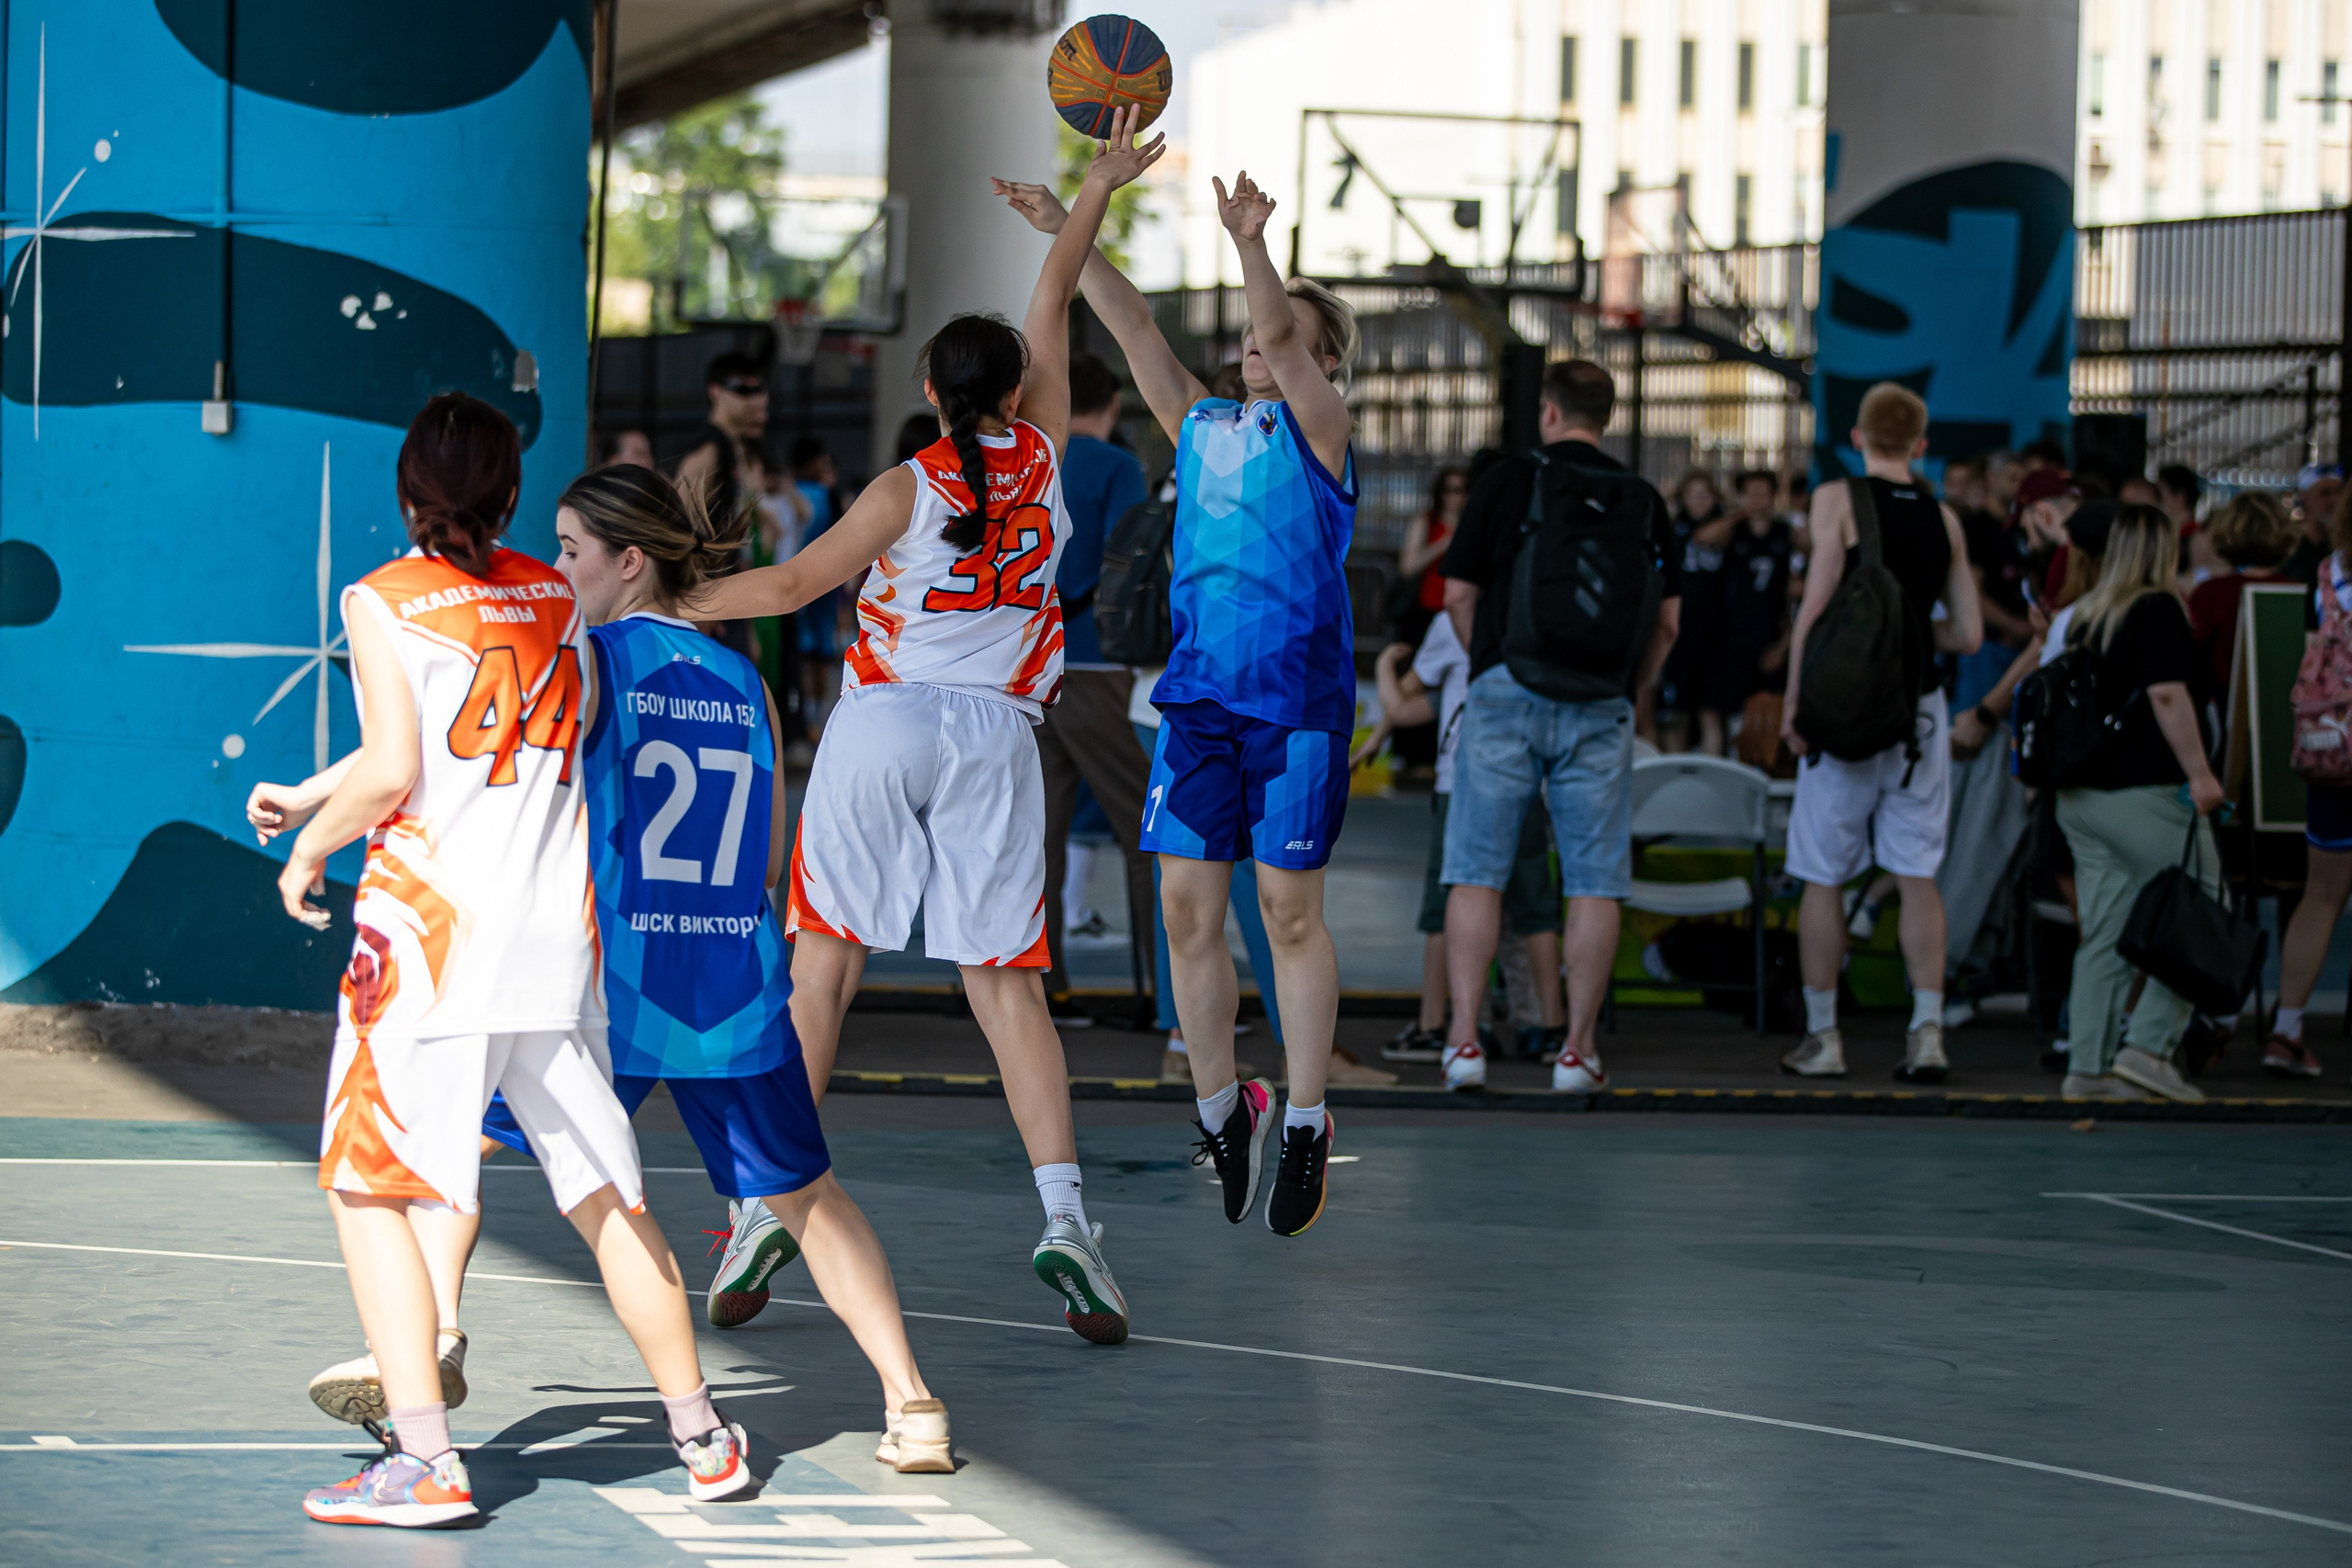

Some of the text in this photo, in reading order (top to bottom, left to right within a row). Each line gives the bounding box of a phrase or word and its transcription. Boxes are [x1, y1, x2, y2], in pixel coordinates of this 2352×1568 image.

[922, 502, 1055, 613] 32
[398, 582, 575, 619] АКАДЕМИЧЕСКИЕ
[478, 605, 537, 623] ЛЬВЫ
[447, 645, 583, 787] 44
[627, 692, 756, 728] ГБОУ ШКОЛА 152
[634, 740, 753, 886] 27
[630, 912, 675, 933] ШСК
